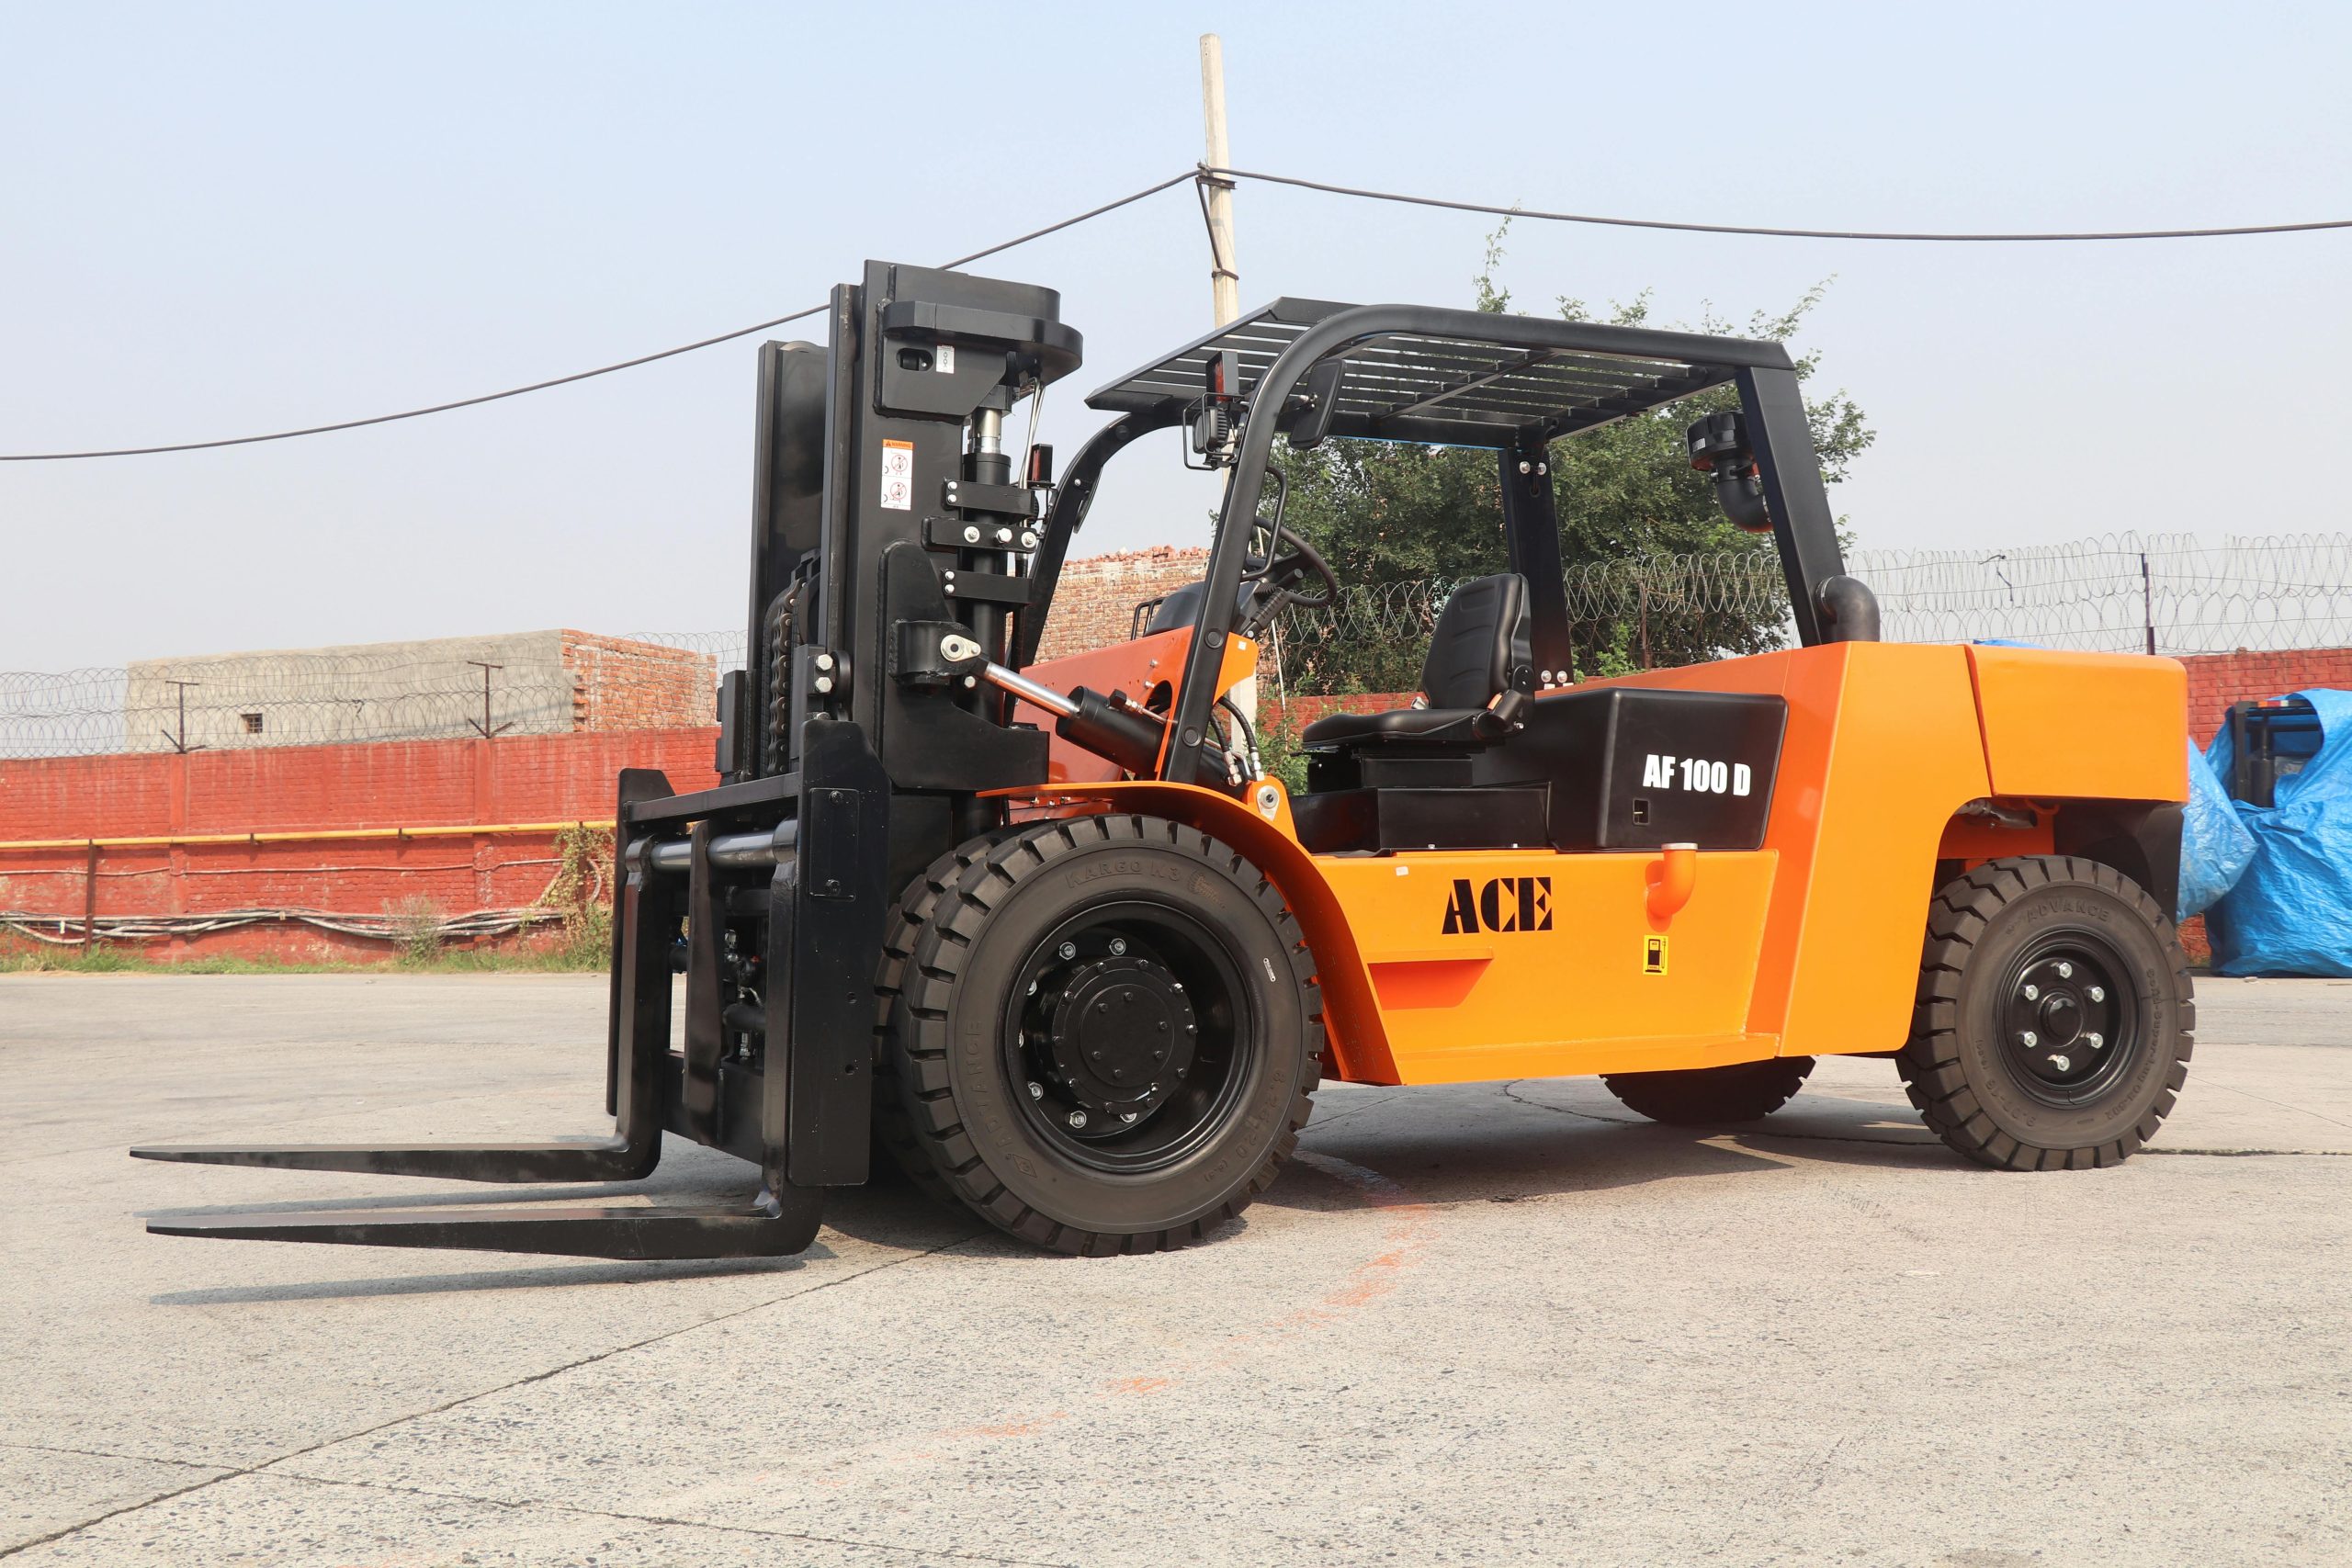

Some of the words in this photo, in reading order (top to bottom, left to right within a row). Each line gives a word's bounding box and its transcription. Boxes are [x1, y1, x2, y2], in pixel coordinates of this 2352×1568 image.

[1643, 753, 1677, 790] AF
[1680, 758, 1728, 795] 100
[1733, 763, 1751, 796] D
[1064, 859, 1143, 889] KARGO
[1442, 876, 1553, 935] ACE
[2026, 897, 2109, 923] ADVANCE
[964, 1020, 1013, 1148] ADVANCE
